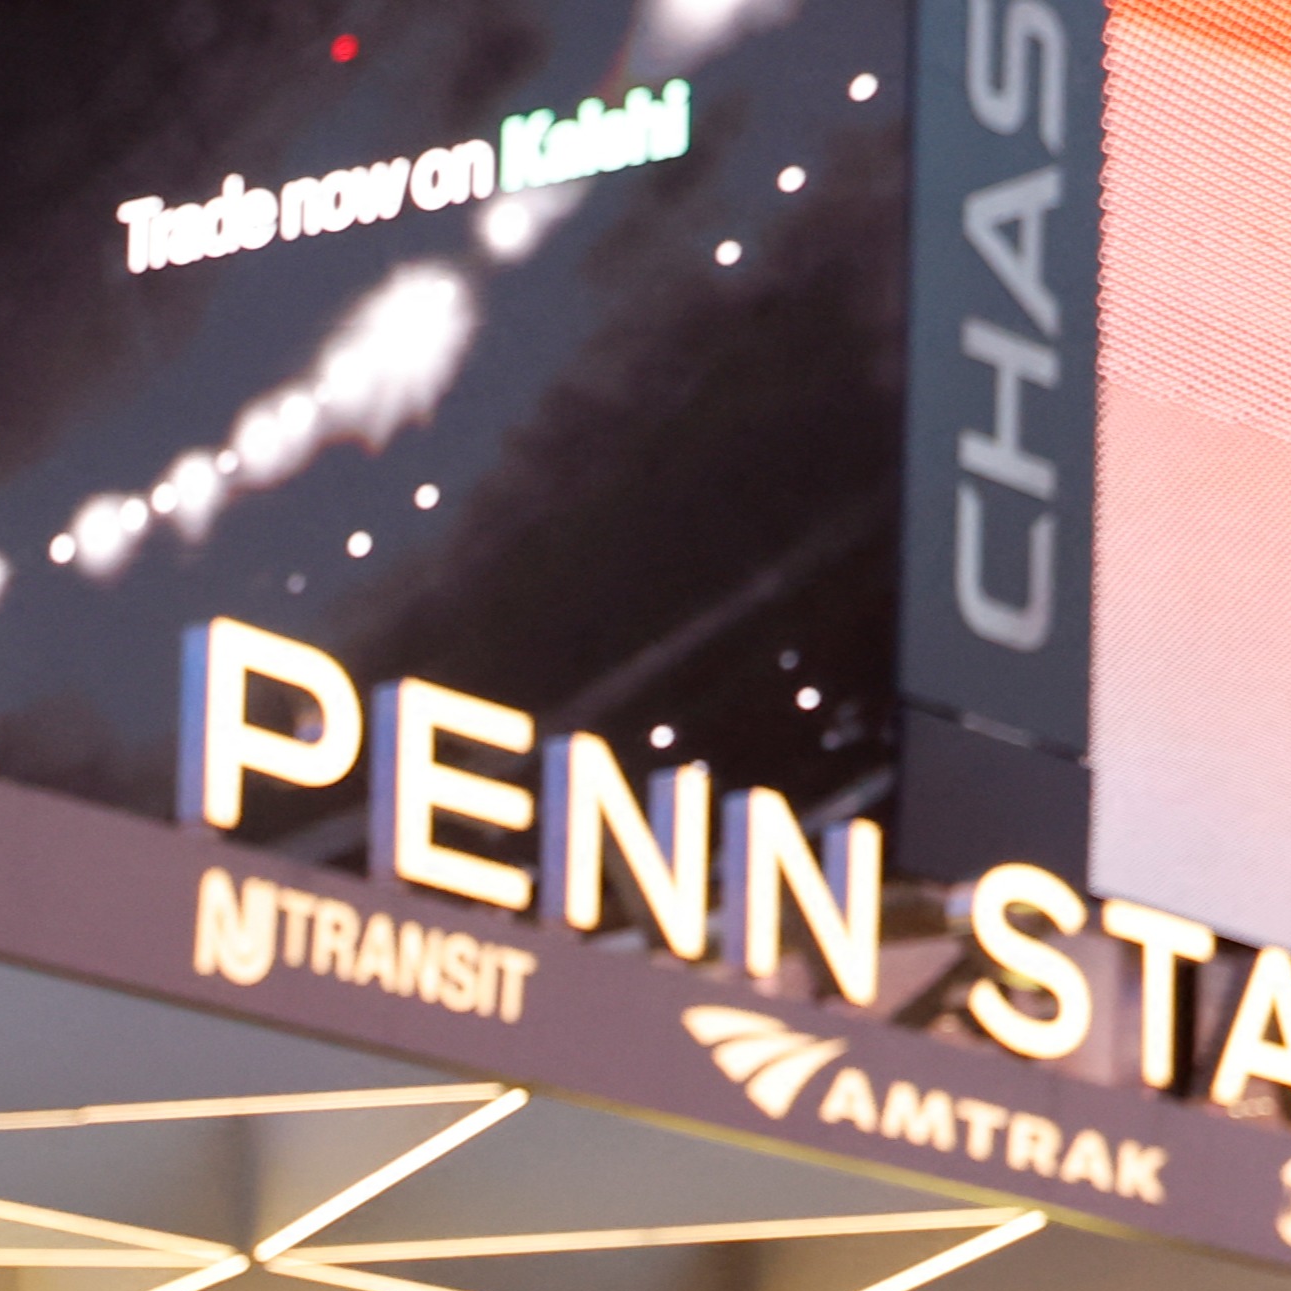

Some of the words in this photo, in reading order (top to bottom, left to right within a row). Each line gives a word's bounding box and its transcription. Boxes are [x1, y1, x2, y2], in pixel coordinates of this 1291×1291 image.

[117, 174, 278, 273] Trade
[280, 158, 410, 240] now
[411, 140, 495, 210] on
[955, 0, 1068, 653] CHAS
[189, 615, 884, 1007] PENN
[279, 888, 538, 1025] TRANSIT
[819, 1068, 1168, 1205] AMTRAK
